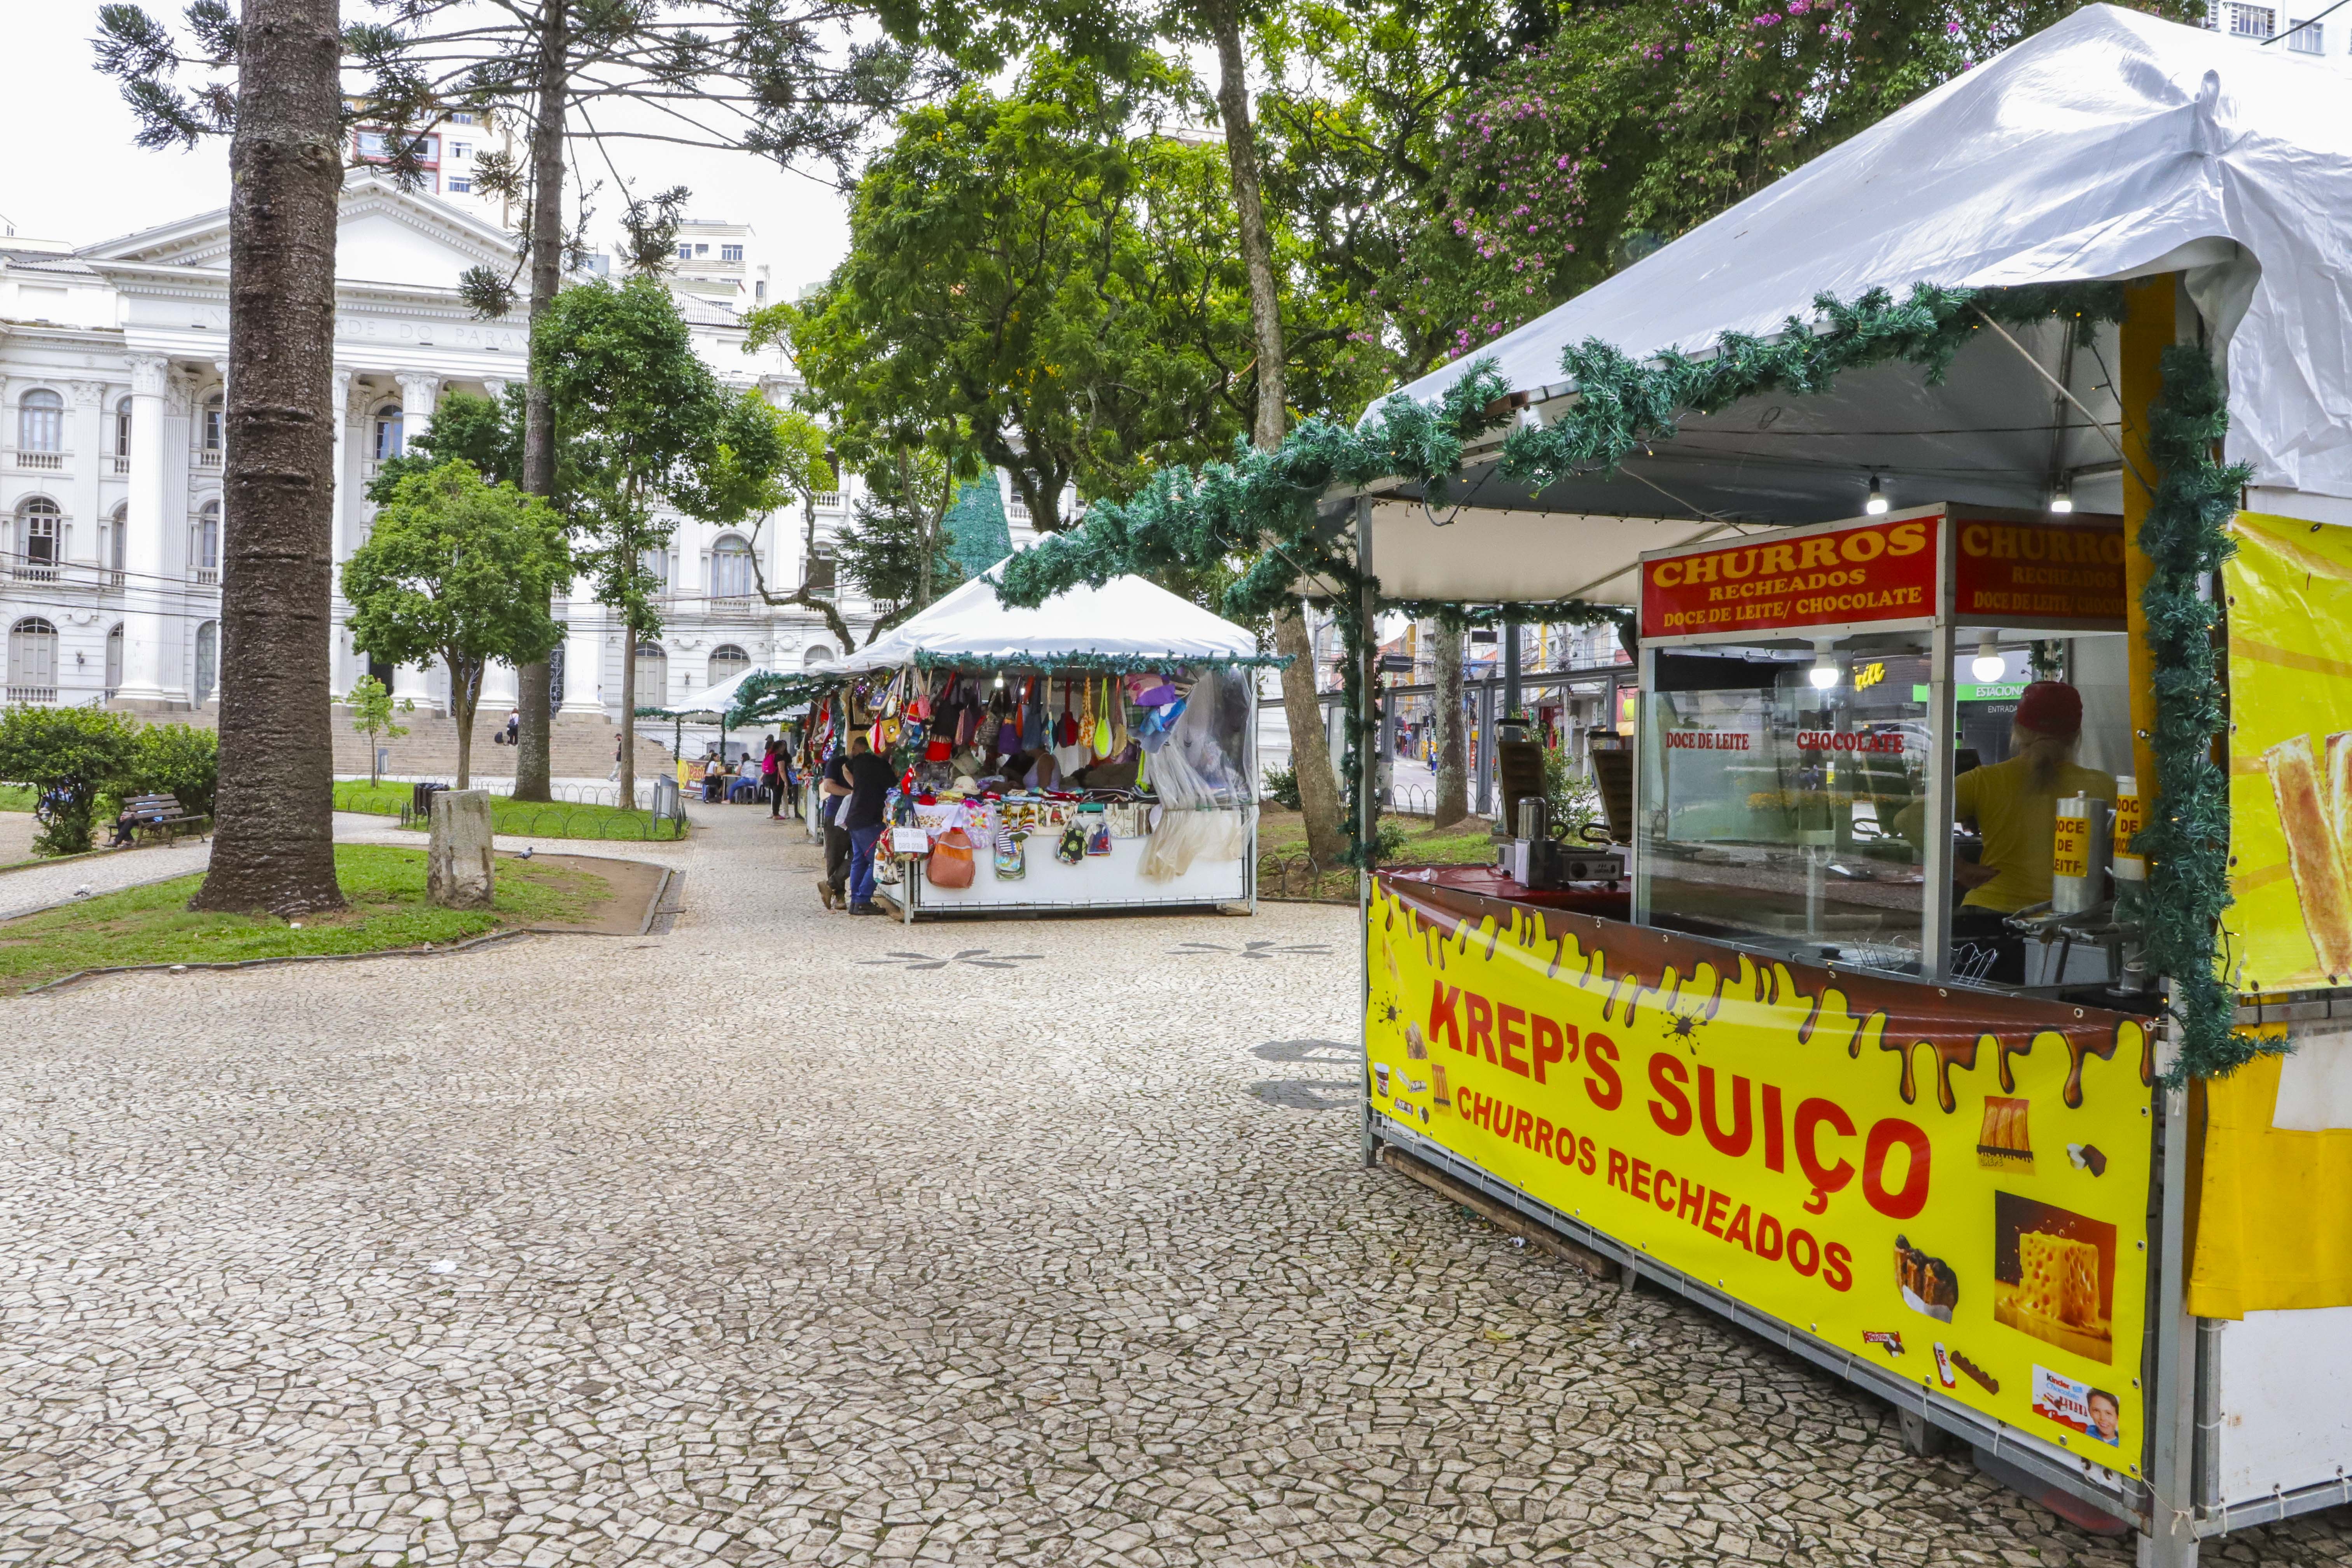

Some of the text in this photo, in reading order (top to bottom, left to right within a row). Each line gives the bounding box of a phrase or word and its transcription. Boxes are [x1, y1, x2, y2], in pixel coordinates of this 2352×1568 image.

[400, 323, 433, 340] DO
[456, 328, 529, 348] PARAN
[1653, 523, 1926, 587] CHURROS
[1962, 524, 2126, 565] CHURRO
[1708, 569, 1866, 602] RECHEADOS
[2012, 566, 2118, 589] RECHEADOS
[1664, 609, 1706, 627] DOCE
[1709, 607, 1732, 623] DE
[1796, 586, 1922, 615] CHOCOLATE
[1973, 591, 2009, 609] DOCE
[2011, 593, 2030, 610] DE
[2077, 597, 2128, 614] CHOCOL
[1852, 663, 1885, 692] rill
[1976, 685, 2024, 697] ESTACIONA
[1666, 732, 1749, 750] DOCE DE LEITE
[1796, 732, 1904, 753] CHOCOLATE
[895, 829, 926, 838] Bolsa Toalha
[2121, 819, 2139, 834] DE
[2058, 839, 2073, 852] DE
[1429, 979, 1931, 1220] KREP'S SUIÇO
[1457, 1086, 1853, 1293] CHURROS RECHEADOS
[2046, 1382, 2080, 1401] Chocolate
